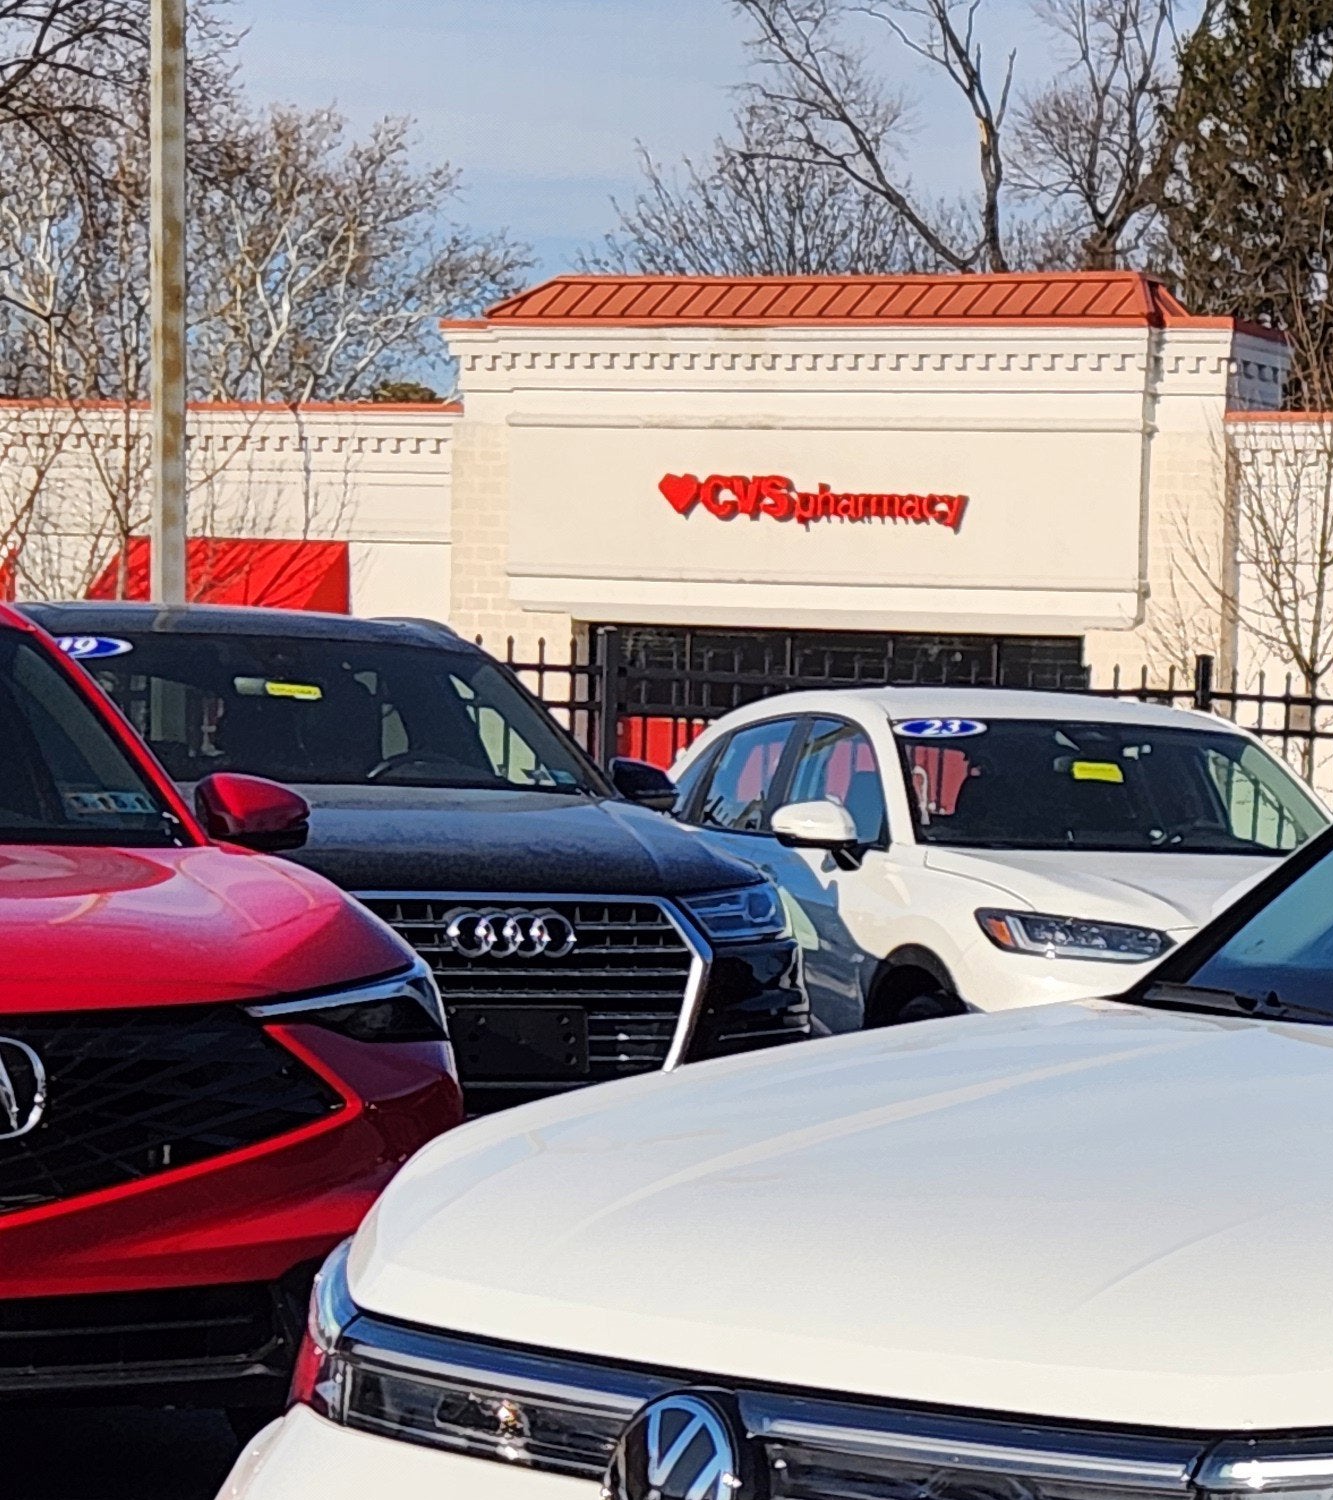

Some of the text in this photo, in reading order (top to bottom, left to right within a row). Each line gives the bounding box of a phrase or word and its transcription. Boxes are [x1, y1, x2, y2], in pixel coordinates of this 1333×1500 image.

[700, 475, 963, 529] CVS pharmacy
[923, 719, 961, 735] 23
